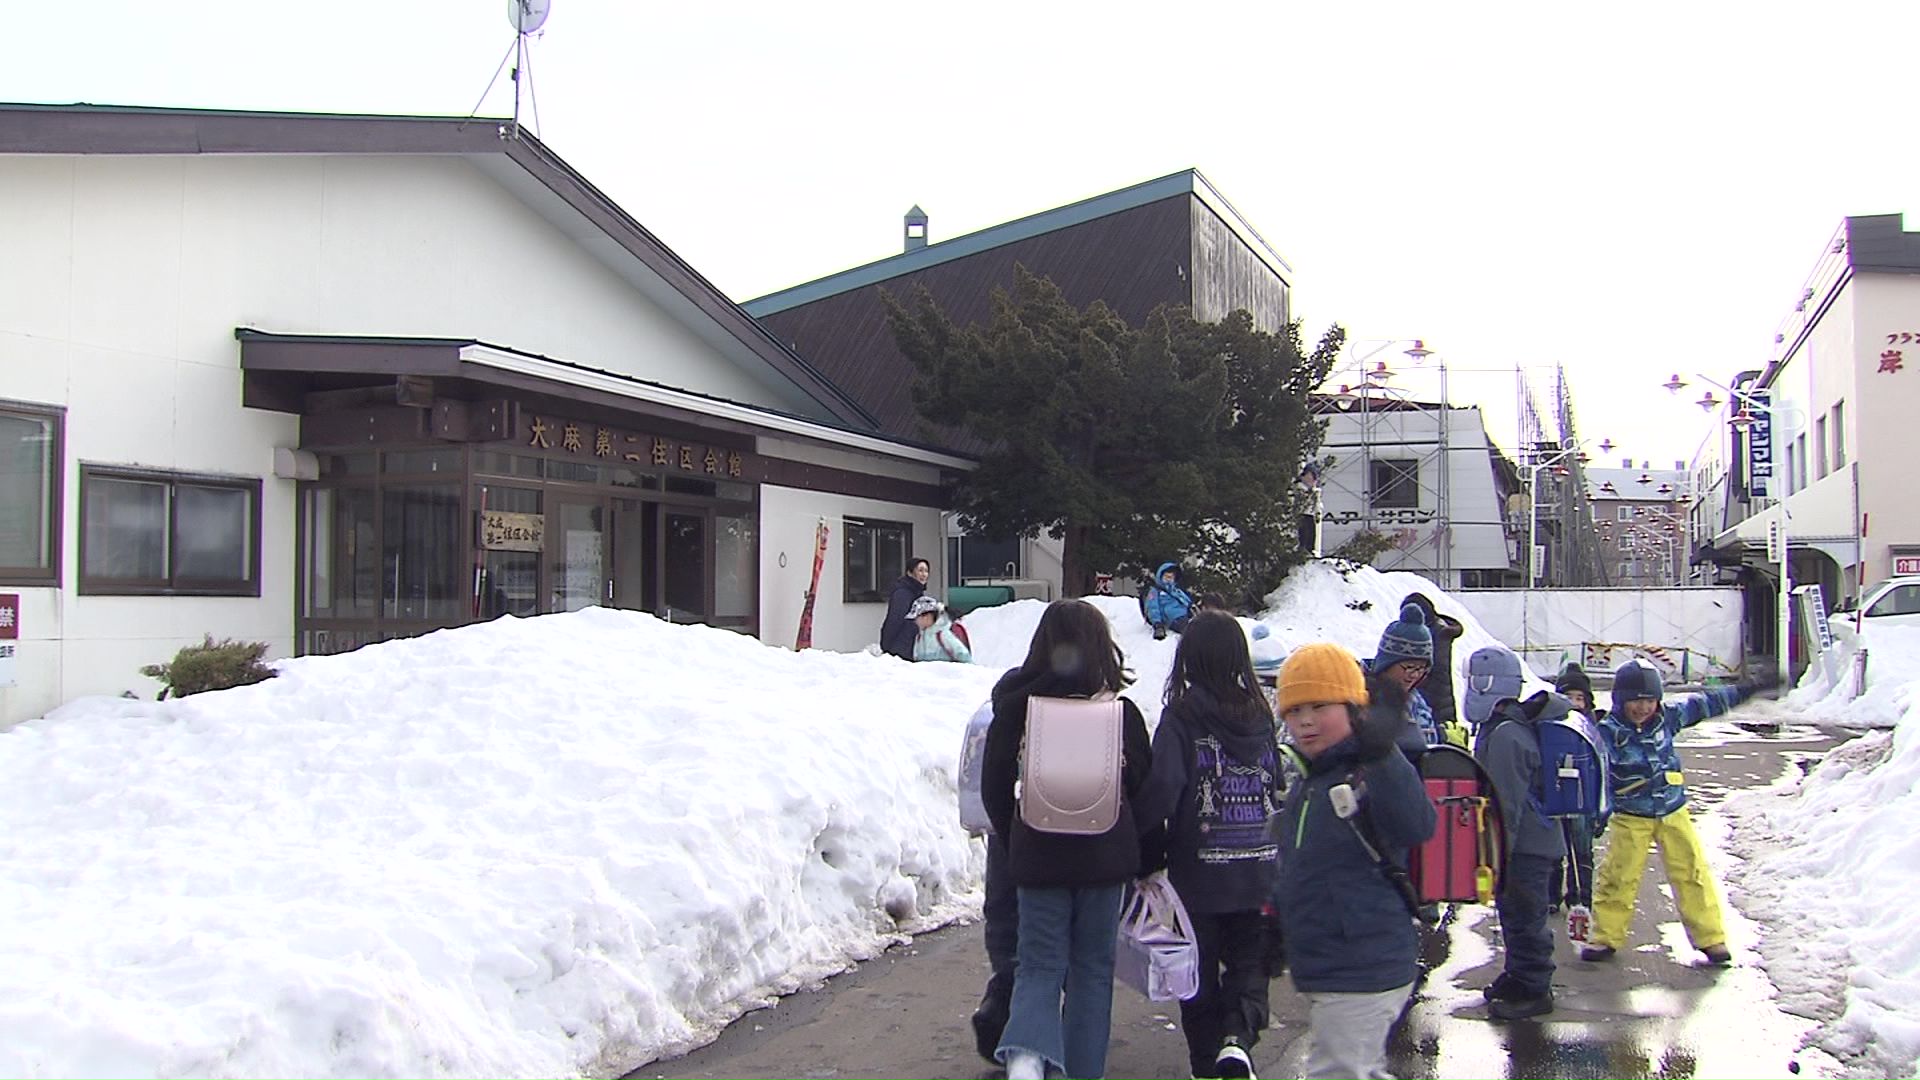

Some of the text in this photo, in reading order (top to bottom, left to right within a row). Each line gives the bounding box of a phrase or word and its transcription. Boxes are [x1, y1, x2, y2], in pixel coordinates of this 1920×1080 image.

[530, 416, 742, 478] 大麻第二住区会館
[1221, 776, 1262, 794] 2024
[1222, 804, 1264, 822] KOBE
